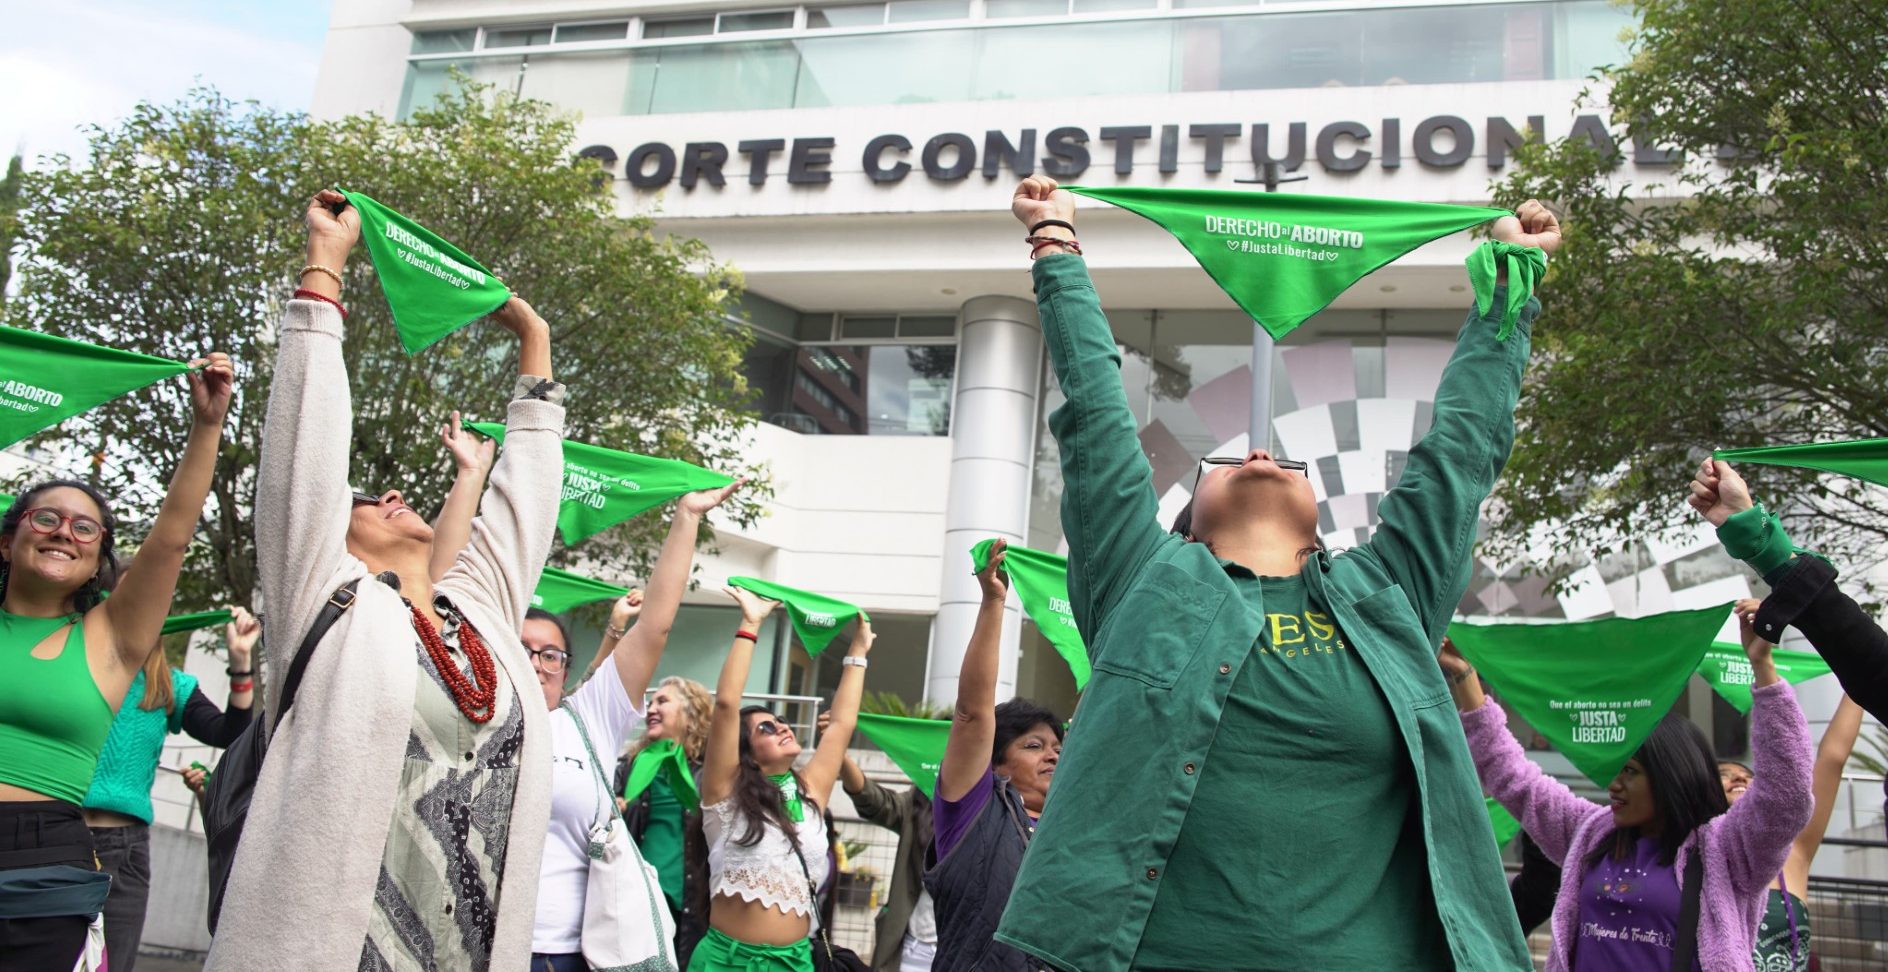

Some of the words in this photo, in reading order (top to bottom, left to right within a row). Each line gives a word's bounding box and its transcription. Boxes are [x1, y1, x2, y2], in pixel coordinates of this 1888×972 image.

[385, 221, 435, 258] DERECHO
[1205, 215, 1281, 239] DERECHO
[1281, 227, 1290, 236] al
[1290, 225, 1364, 249] ABORTO
[1241, 240, 1325, 261] #JustaLibertad
[404, 252, 462, 287] #JustaLibertad
[3, 380, 64, 407] ABORTO
[1550, 700, 1563, 709] Que
[1573, 700, 1597, 709] aborto
[1609, 701, 1621, 709] sea
[1633, 698, 1651, 708] delito
[1579, 710, 1618, 727] JUSTA
[1572, 726, 1626, 743] LIBERTAD
[1619, 926, 1629, 940] de
